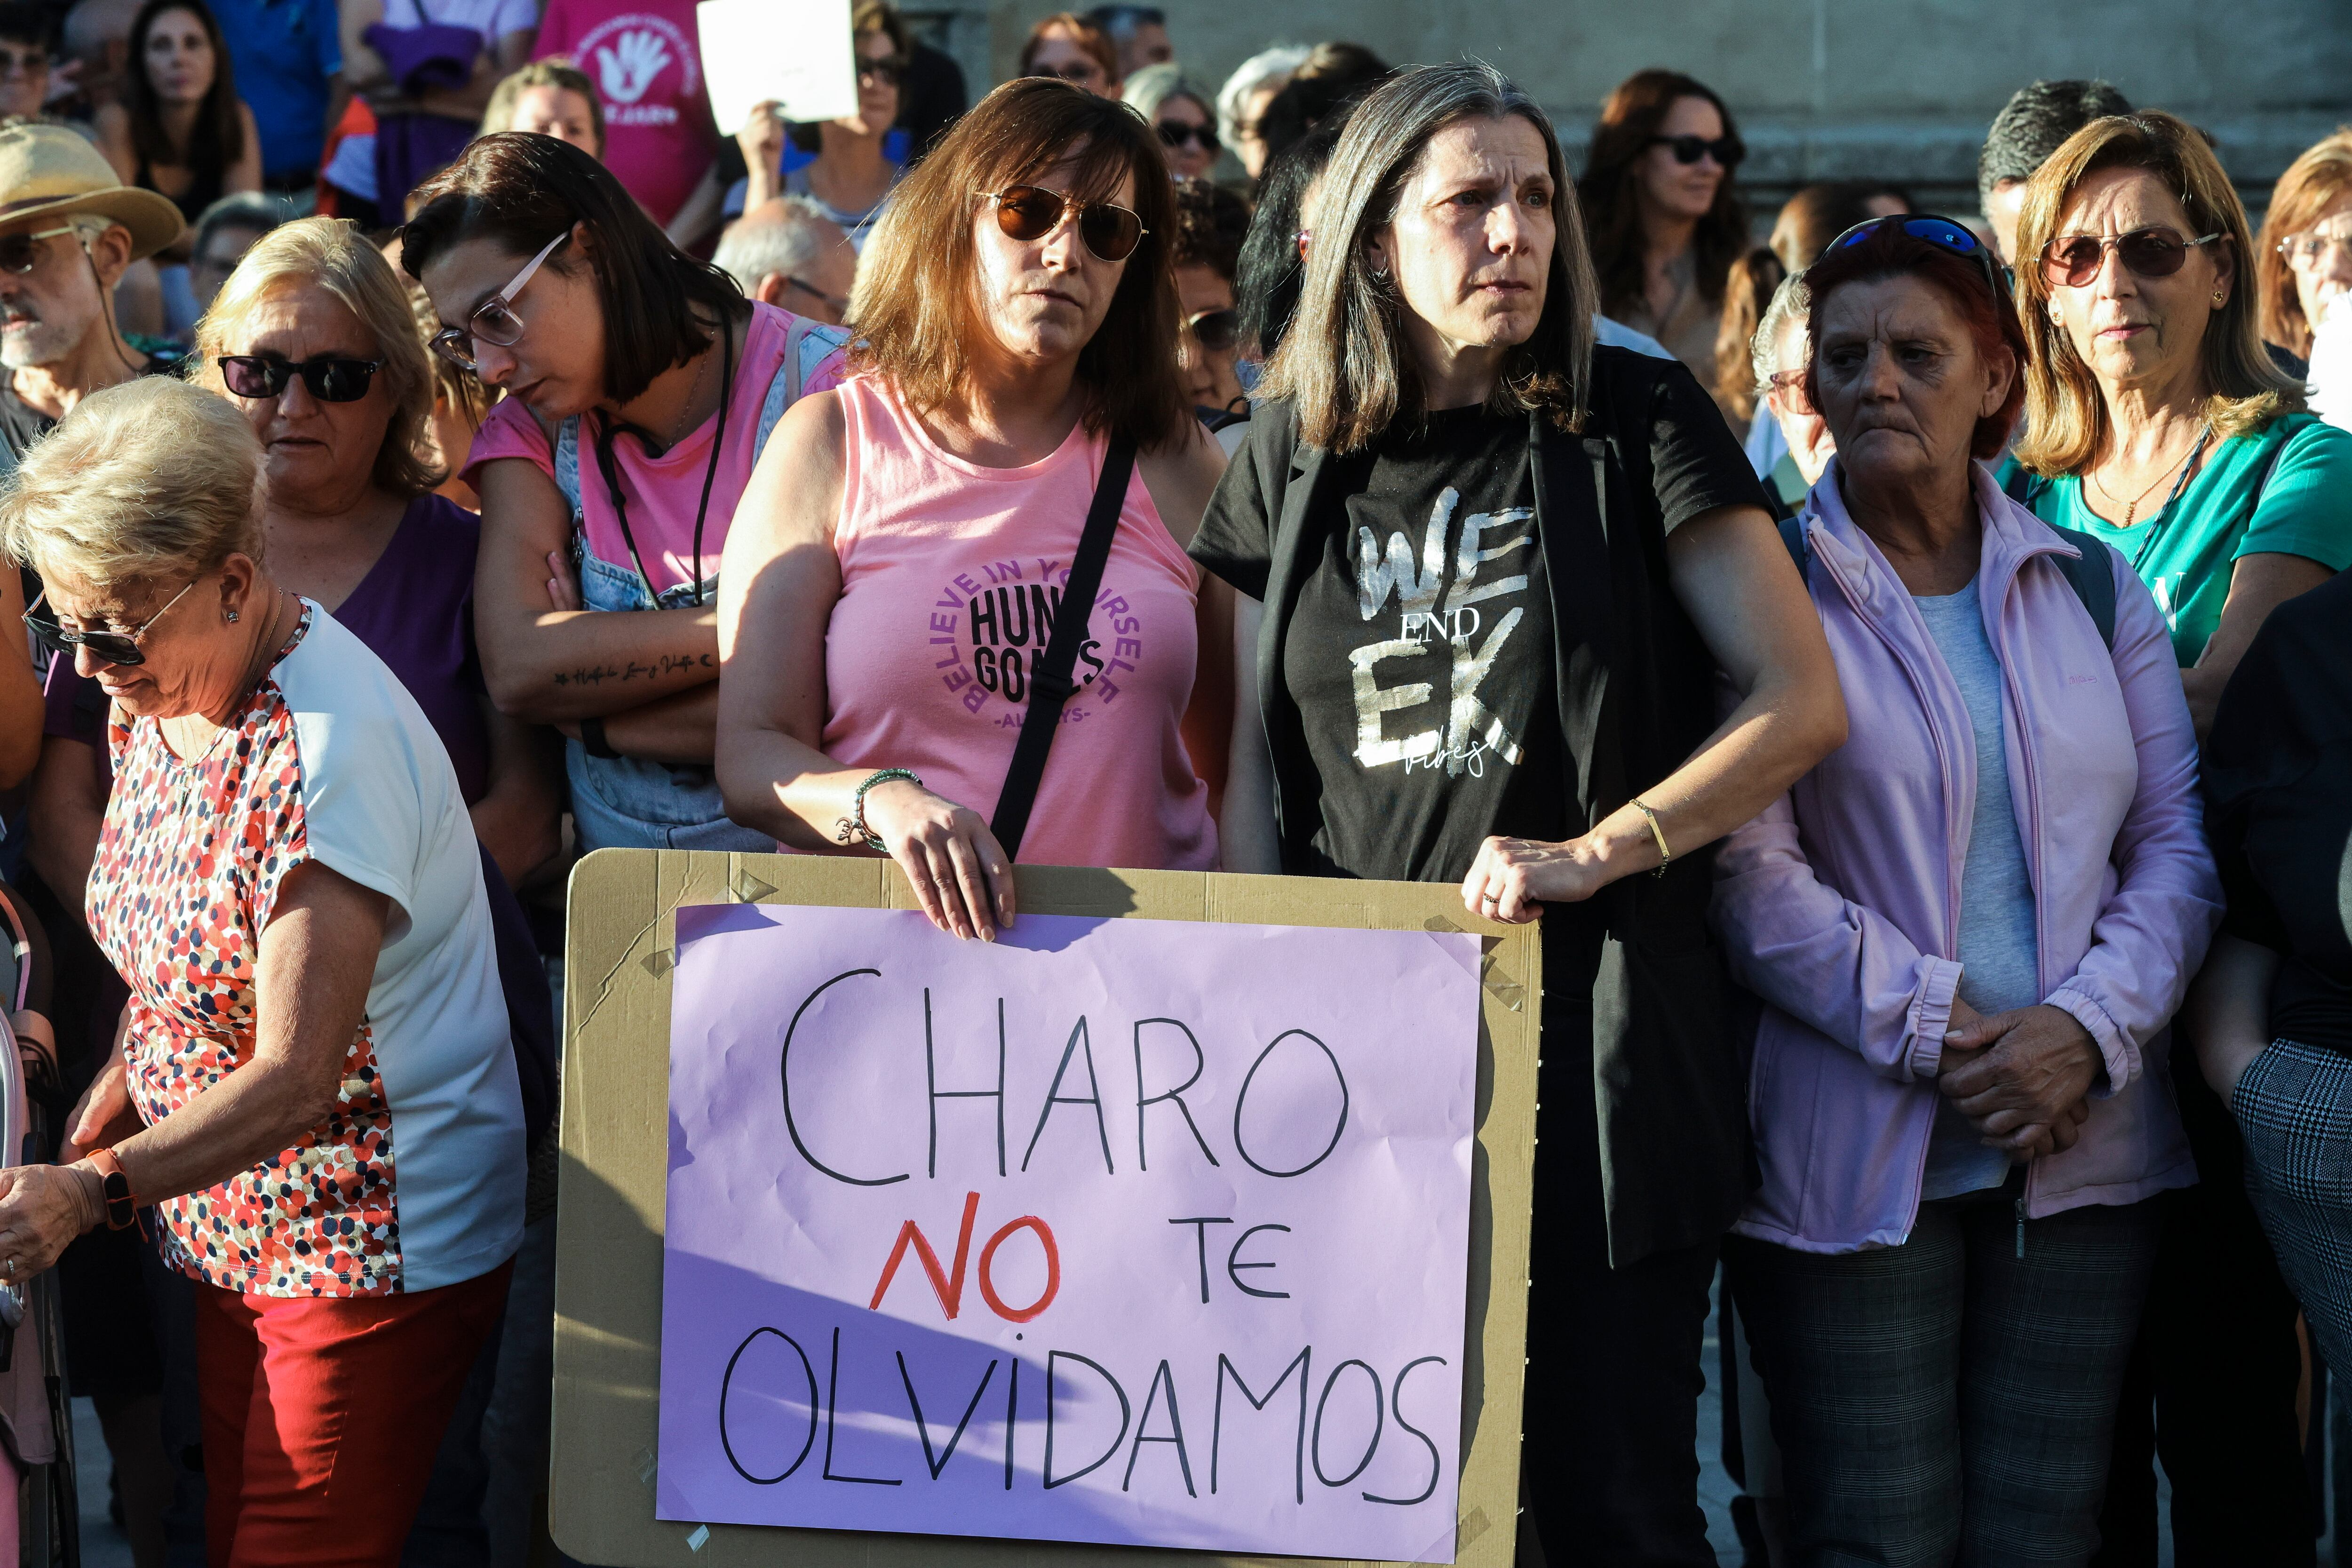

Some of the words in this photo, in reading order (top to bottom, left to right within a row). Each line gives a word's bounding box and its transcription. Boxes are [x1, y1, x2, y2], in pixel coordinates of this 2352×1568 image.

[1358, 486, 1536, 629] WE
[1399, 607, 1480, 645] END
[930, 573, 990, 714] BELIEVE
[982, 559, 1022, 583] IN
[1348, 607, 1524, 779] EK
[1403, 724, 1493, 778] vibes
[781, 968, 1349, 1186] CHARO
[870, 1192, 1060, 1323] NO
[1168, 1218, 1291, 1304] TE
